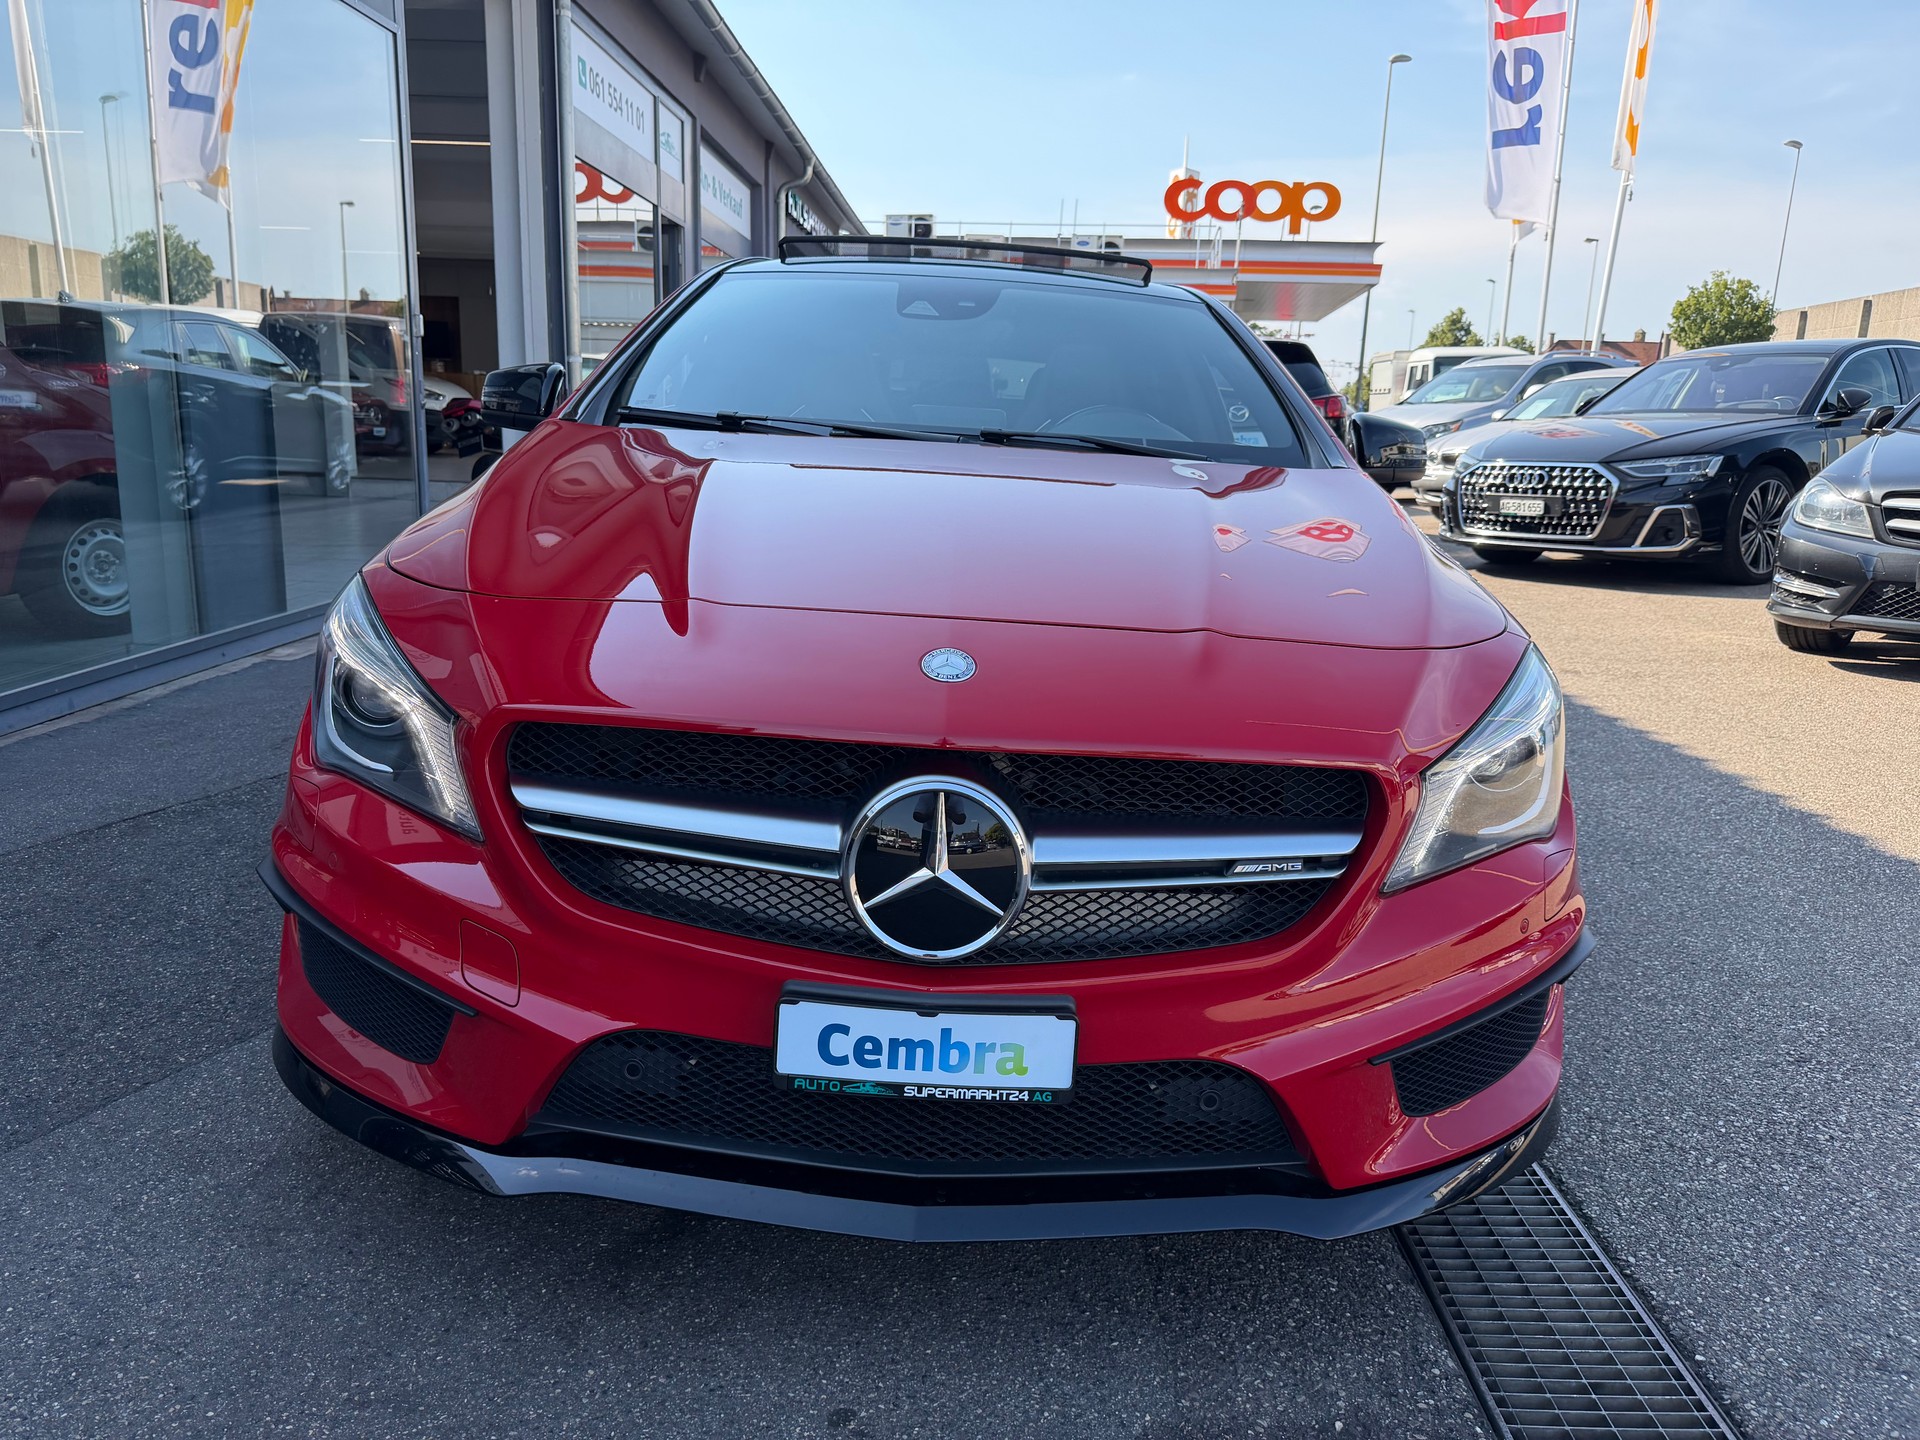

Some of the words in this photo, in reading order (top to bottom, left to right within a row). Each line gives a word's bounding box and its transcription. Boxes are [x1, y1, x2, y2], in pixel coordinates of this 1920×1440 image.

[168, 0, 219, 115] re
[589, 66, 605, 103] 061
[608, 82, 623, 117] 554
[625, 97, 634, 126] 11
[636, 106, 645, 135] 01
[719, 180, 743, 219] Verkauf
[1164, 180, 1341, 234] coop
[1255, 862, 1302, 873] AMG
[817, 1023, 1029, 1077] Cembra
[794, 1078, 841, 1092] AUTO
[1033, 1091, 1053, 1102] AG
